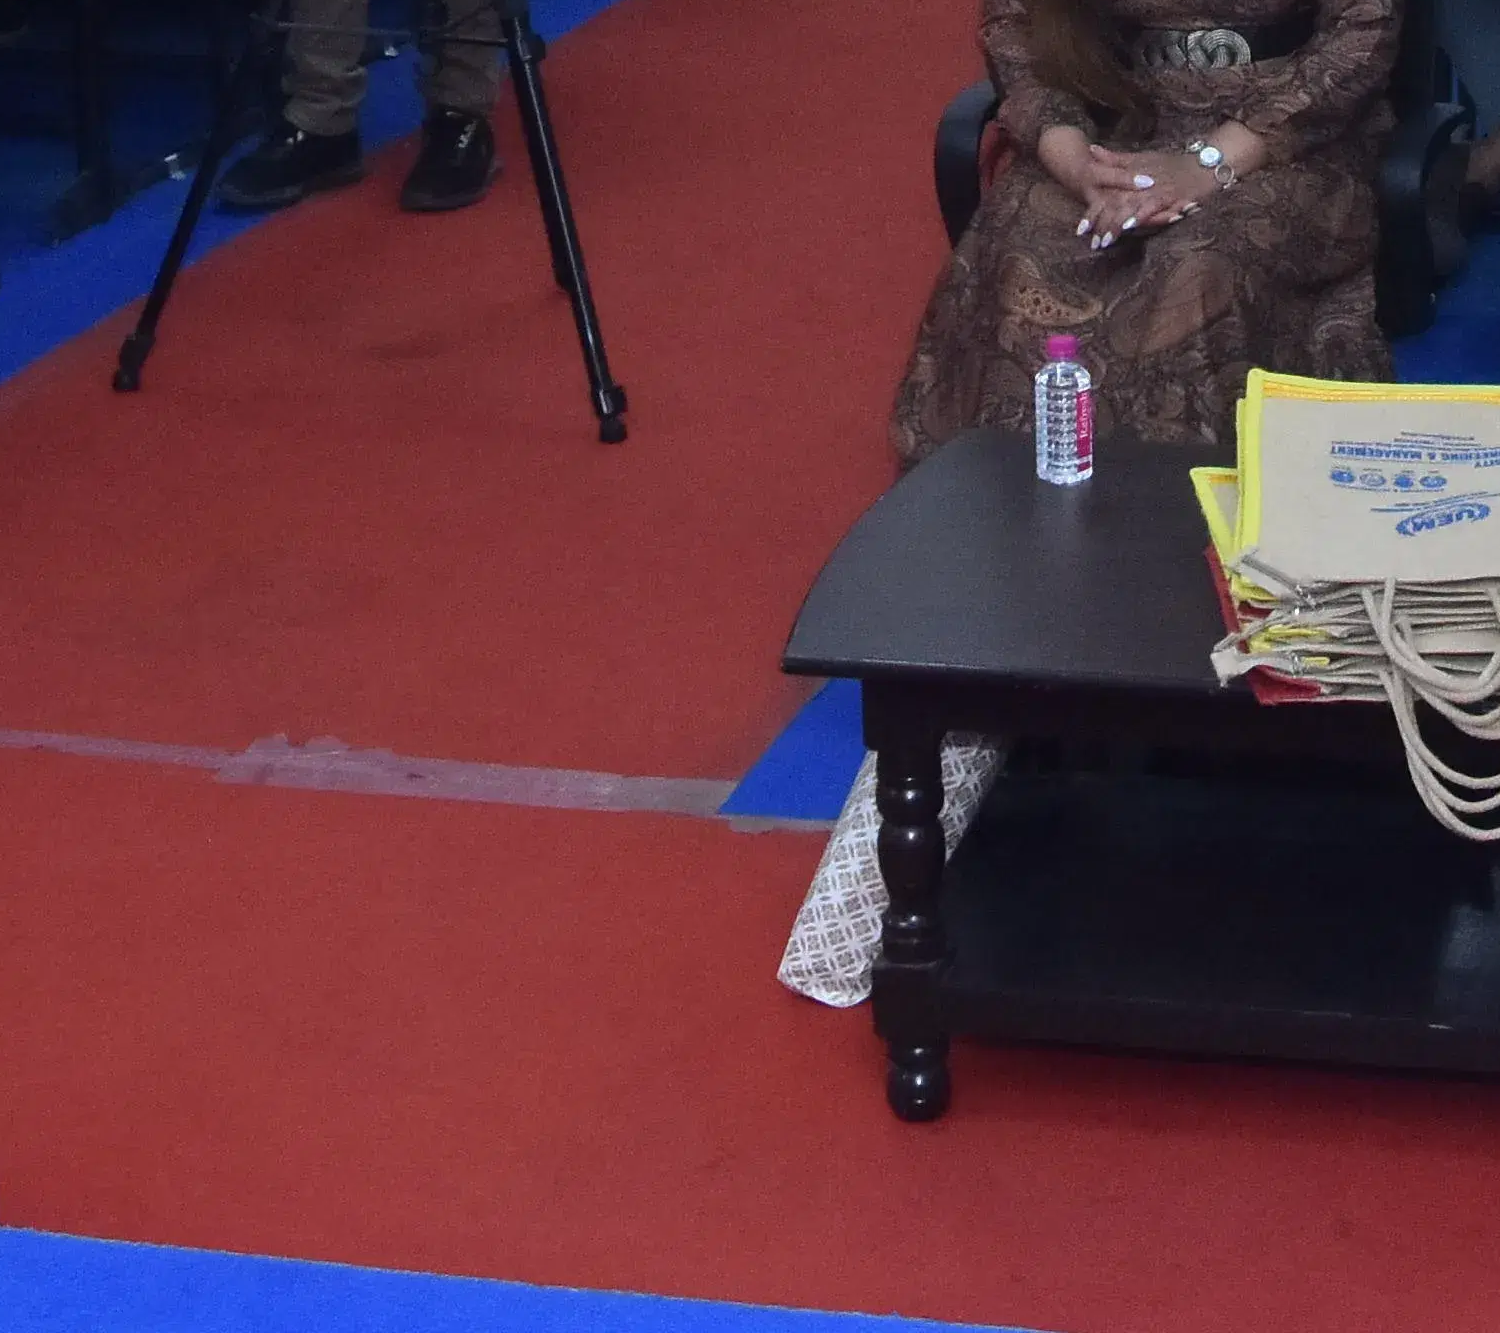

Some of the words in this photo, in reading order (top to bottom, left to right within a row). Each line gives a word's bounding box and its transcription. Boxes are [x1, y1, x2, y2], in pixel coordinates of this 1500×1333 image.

[1330, 445, 1423, 461] MANAGEMENT
[1427, 452, 1437, 461] &
[1409, 509, 1476, 533] UEM
